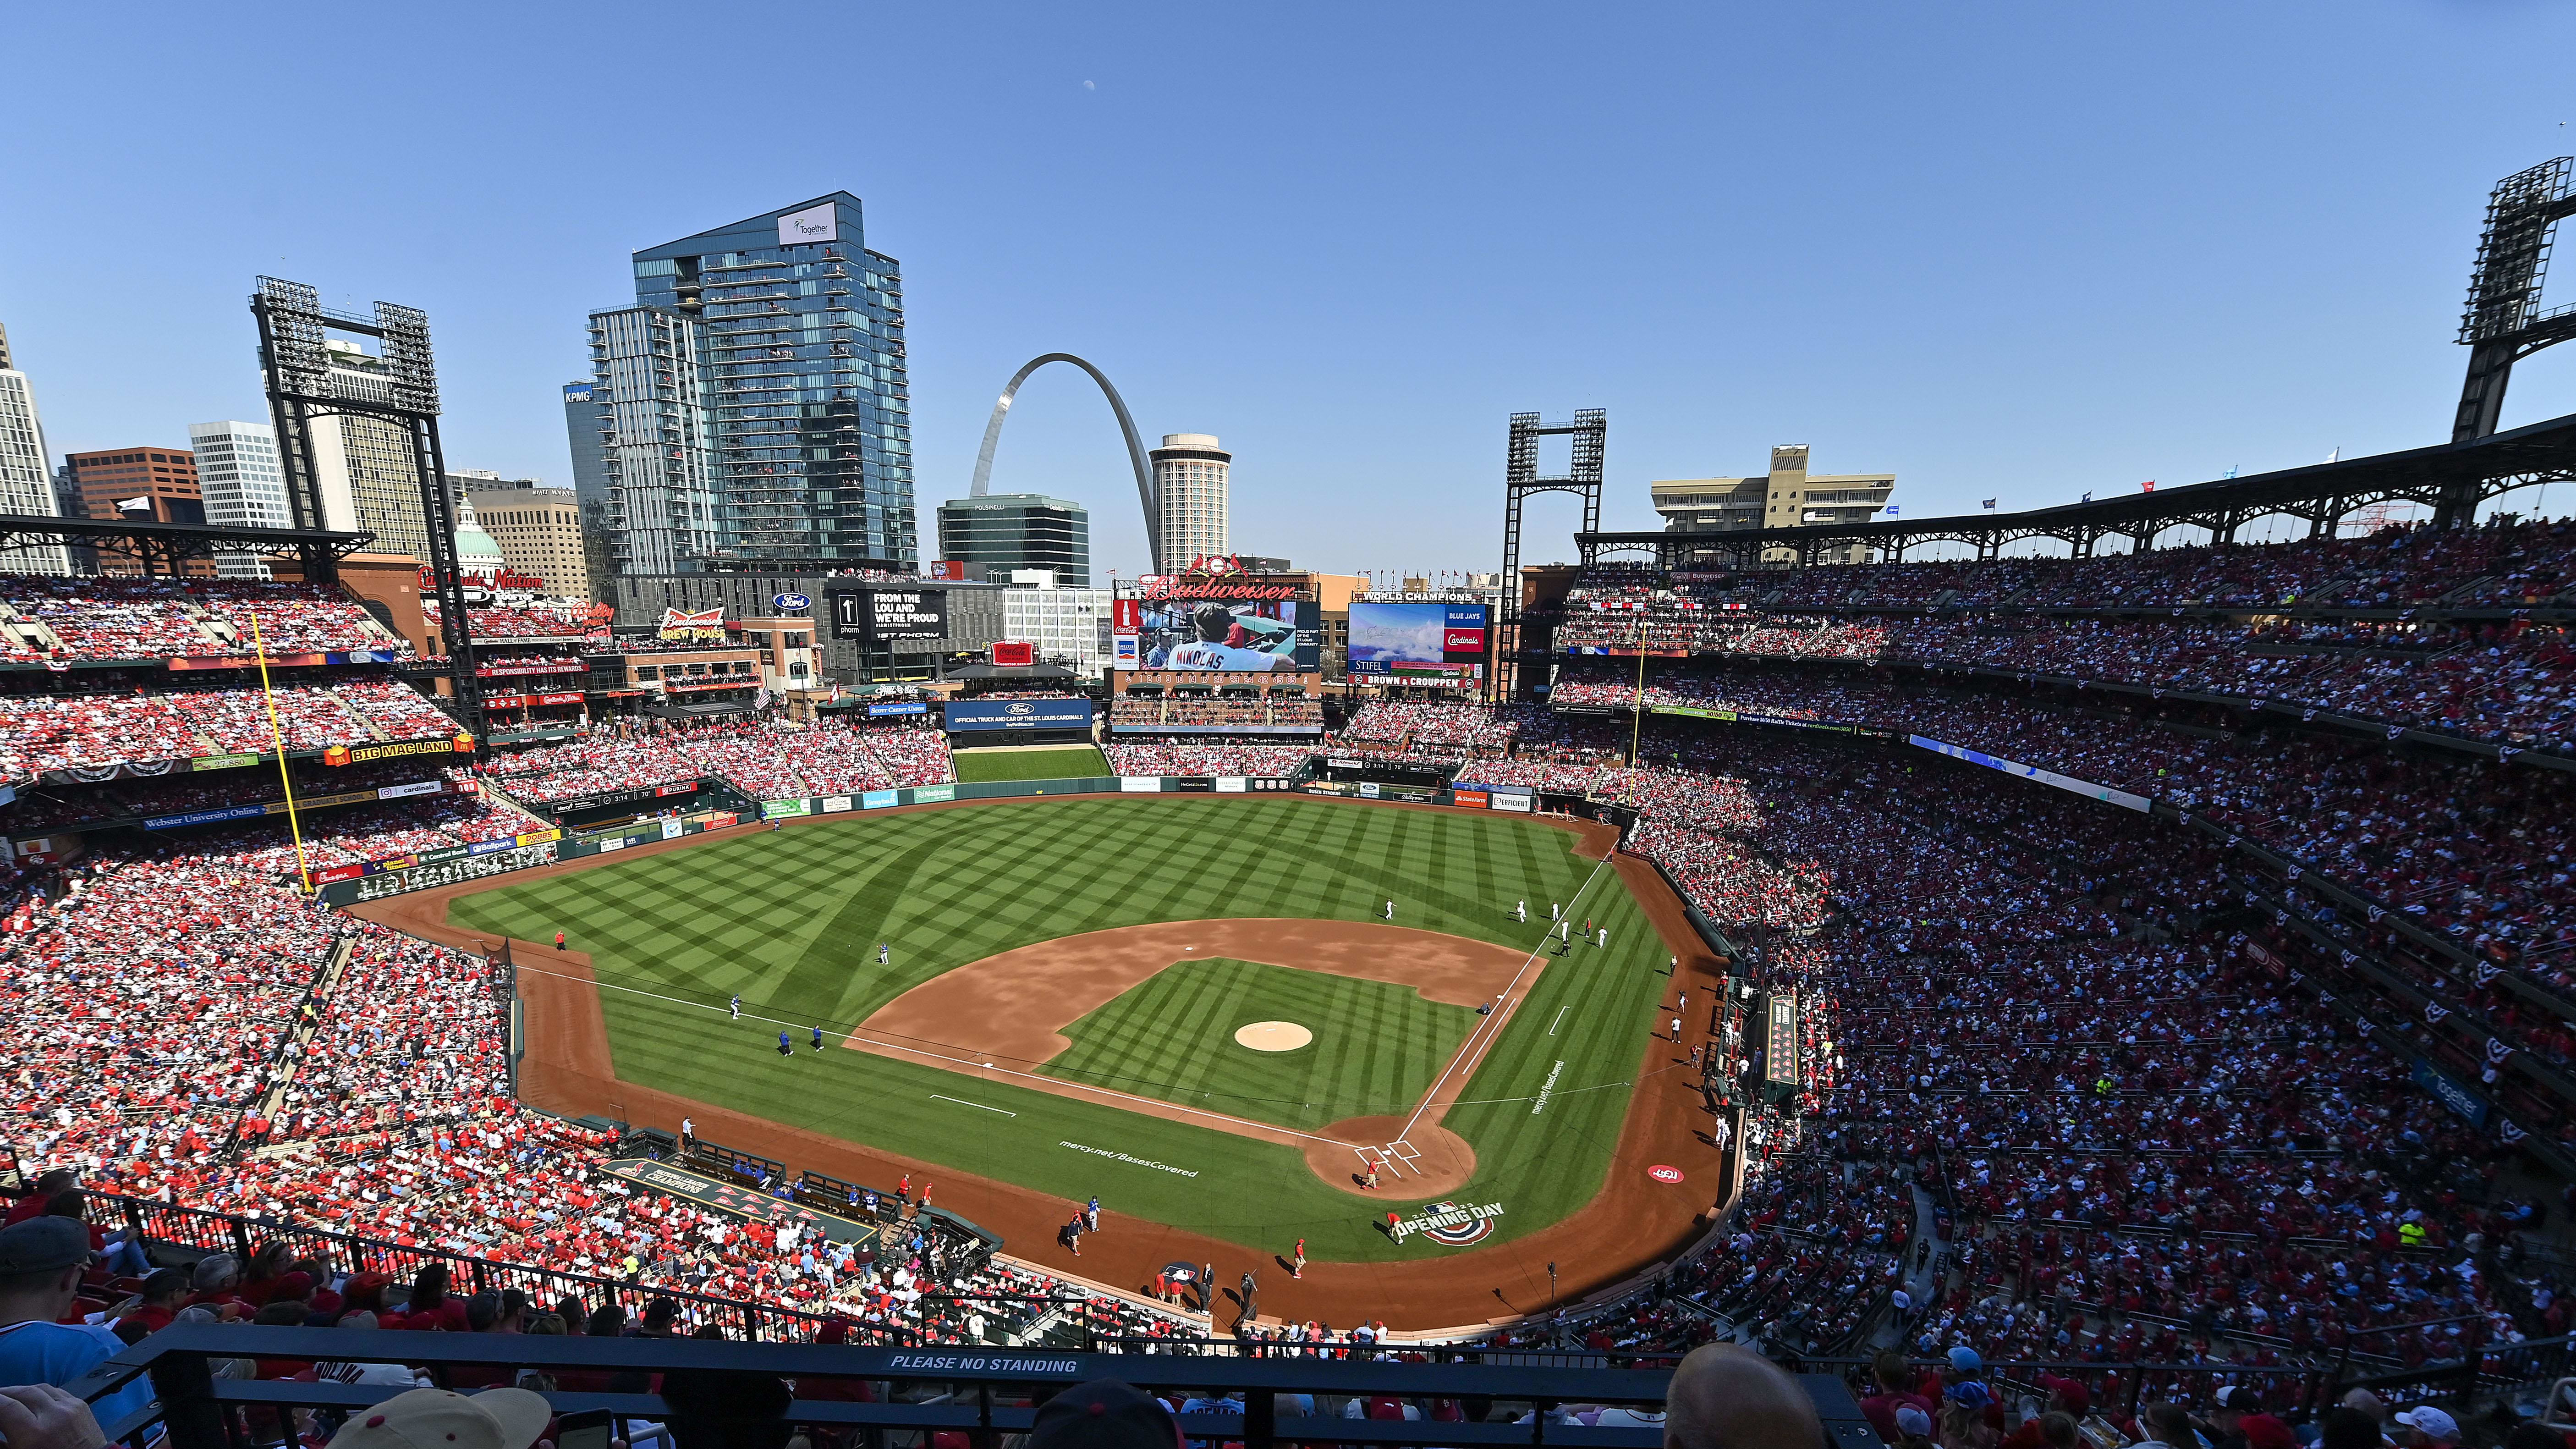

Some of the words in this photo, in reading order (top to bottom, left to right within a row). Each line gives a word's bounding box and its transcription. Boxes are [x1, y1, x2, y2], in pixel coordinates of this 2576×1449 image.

[800, 225, 828, 235] Together
[566, 391, 590, 402] KPMG
[486, 567, 543, 591] Nation
[1138, 574, 1296, 601] Budweiser
[781, 595, 804, 607] Ford
[874, 593, 902, 603] FROM
[903, 594, 921, 603] THE
[1363, 592, 1403, 601] WORLD
[1406, 592, 1472, 601] CHAMPIONS
[874, 603, 894, 613] LOU
[895, 603, 915, 612] AND
[658, 615, 724, 628] Budweiser
[875, 613, 906, 623] WE'RE
[907, 613, 939, 623] PROUD
[660, 629, 690, 639] BREW
[692, 629, 725, 638] HOUSE
[1448, 634, 1478, 646] Cardinals
[999, 647, 1027, 656] Coca-Cola
[1176, 650, 1225, 669] MIKOLAS
[1356, 660, 1383, 670] STIFEL
[491, 667, 535, 676] RESPONSIBILITY
[1139, 675, 1142, 683] 1
[1147, 675, 1152, 683] 2
[1156, 675, 1161, 683] 6
[1166, 675, 1171, 683] 9
[1176, 675, 1184, 683] 10
[1188, 675, 1197, 683] 14
[1201, 675, 1209, 684] 17
[1214, 676, 1224, 684] 20
[1229, 676, 1240, 684] 23
[1244, 676, 1254, 684] 24
[1258, 676, 1269, 684] 42
[1273, 676, 1283, 684] 45
[1286, 676, 1296, 684] 85
[1368, 676, 1400, 685] BROWN
[1410, 678, 1458, 687] CROUPPEN
[1011, 705, 1029, 713] Ford
[1807, 723, 1851, 733] cardinals.com/5050
[352, 747, 380, 762] BIG
[382, 743, 415, 759] MAC
[416, 740, 453, 754] LAND
[192, 754, 257, 762] CARDINALS.COM/5050
[403, 784, 434, 793] cardinals
[924, 788, 953, 797] National
[302, 797, 338, 807] GRADUATE
[339, 793, 365, 803] SCHOOL
[1494, 798, 1528, 807] PERFICIENT
[145, 816, 182, 828] Webster
[184, 811, 229, 824] University
[230, 807, 259, 817] Online
[526, 832, 552, 842] DOBBS
[481, 839, 512, 852] Ballpark
[428, 851, 451, 860] Central
[452, 848, 468, 856] Bank
[382, 859, 405, 868] planet
[386, 863, 410, 871] fitness
[1532, 1060, 1565, 1114] mercy.net/BasesCovered
[2437, 1075, 2477, 1114] Together
[1059, 1140, 1199, 1178] mercy.net/BasesCovered
[645, 1173, 705, 1194] CHAMPIONS
[682, 1176, 710, 1189] LEAGUE
[1398, 1210, 1472, 1237] OPENING
[1470, 1202, 1505, 1219] DAY
[890, 1356, 957, 1368] PLEASE
[959, 1358, 985, 1370] NO
[989, 1359, 1077, 1372] STANDING
